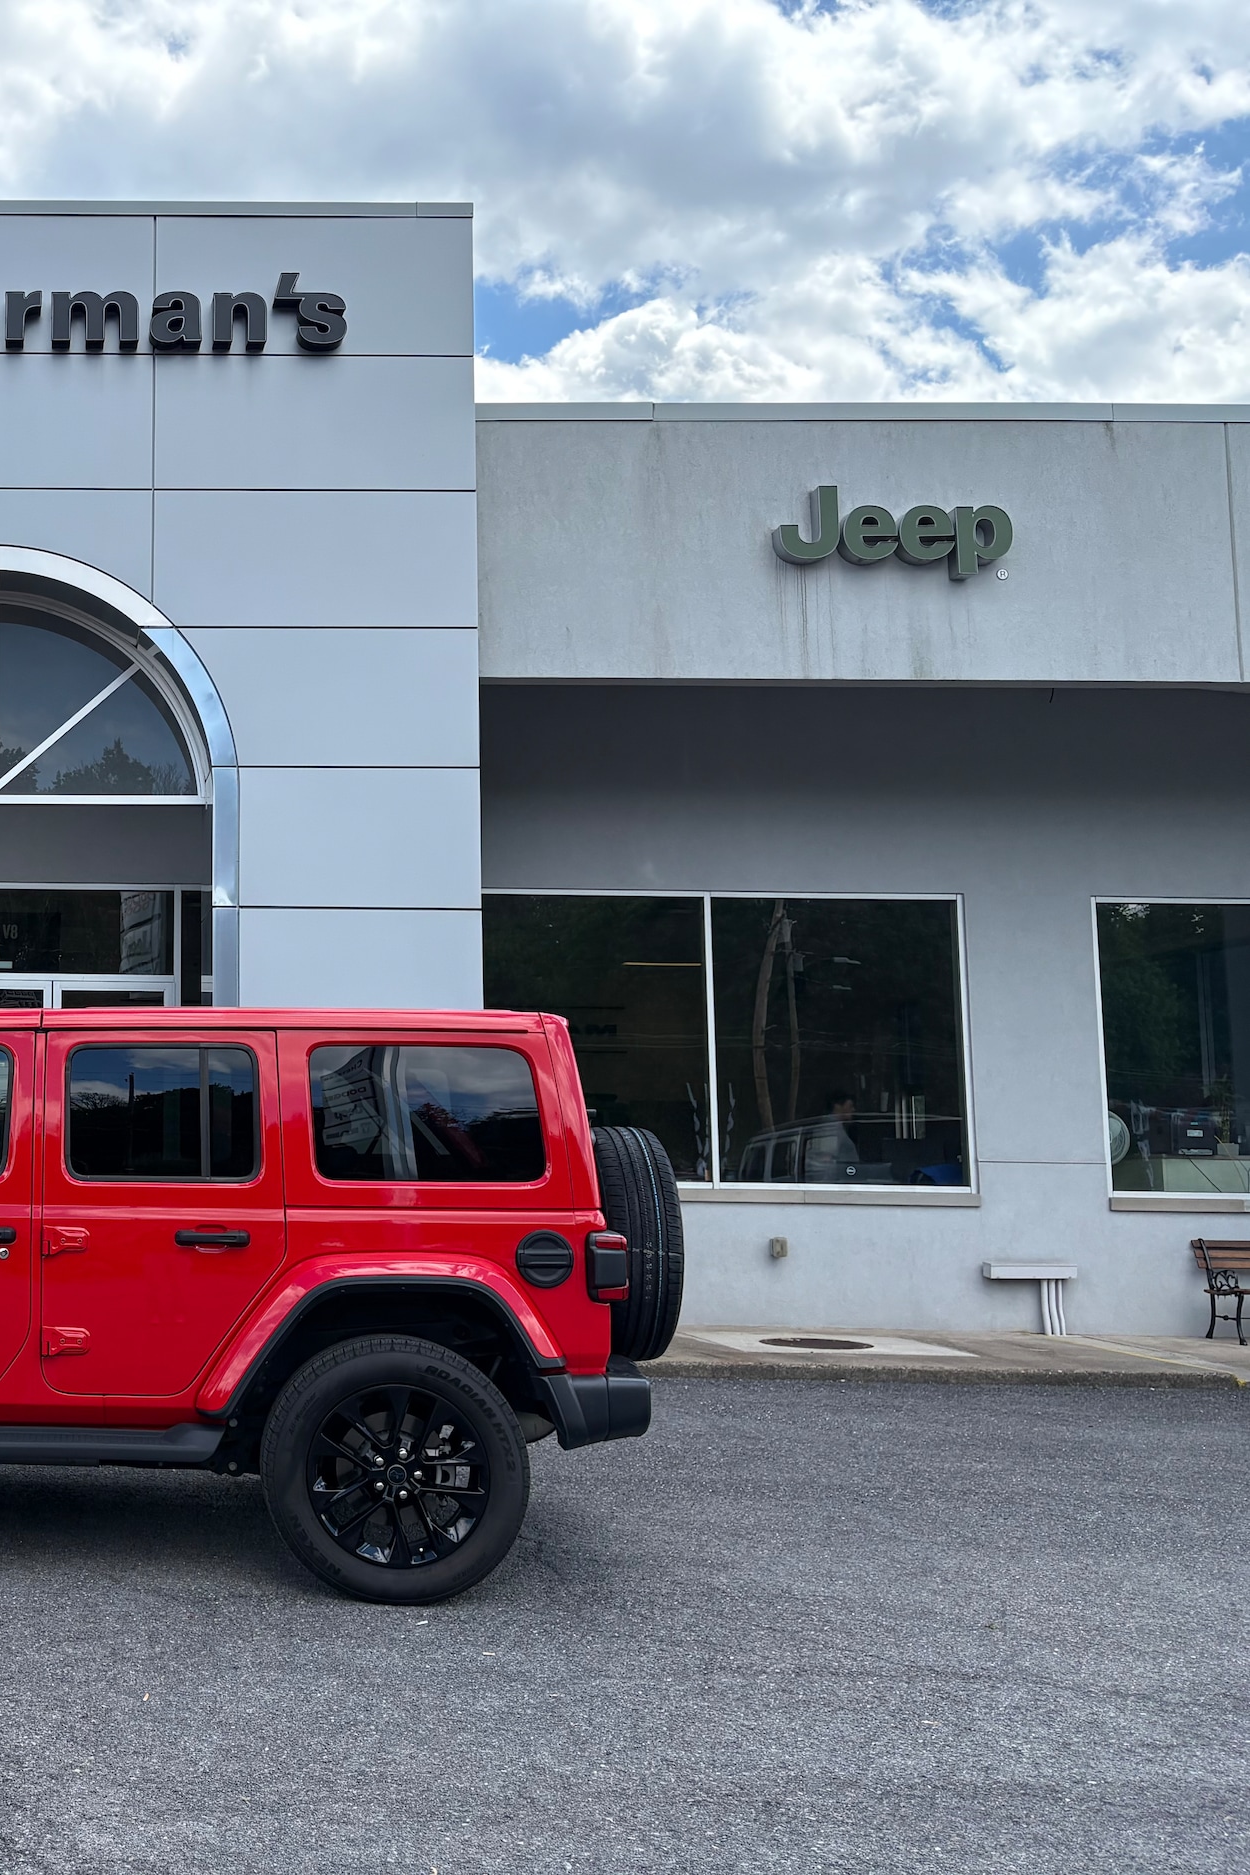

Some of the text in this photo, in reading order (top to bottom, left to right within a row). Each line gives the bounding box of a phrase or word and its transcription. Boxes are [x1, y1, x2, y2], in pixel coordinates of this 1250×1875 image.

[771, 485, 1013, 581] Jeep
[3, 923, 19, 939] V8
[424, 1365, 497, 1419] ROADIAN
[288, 1513, 342, 1576] NEXEN
